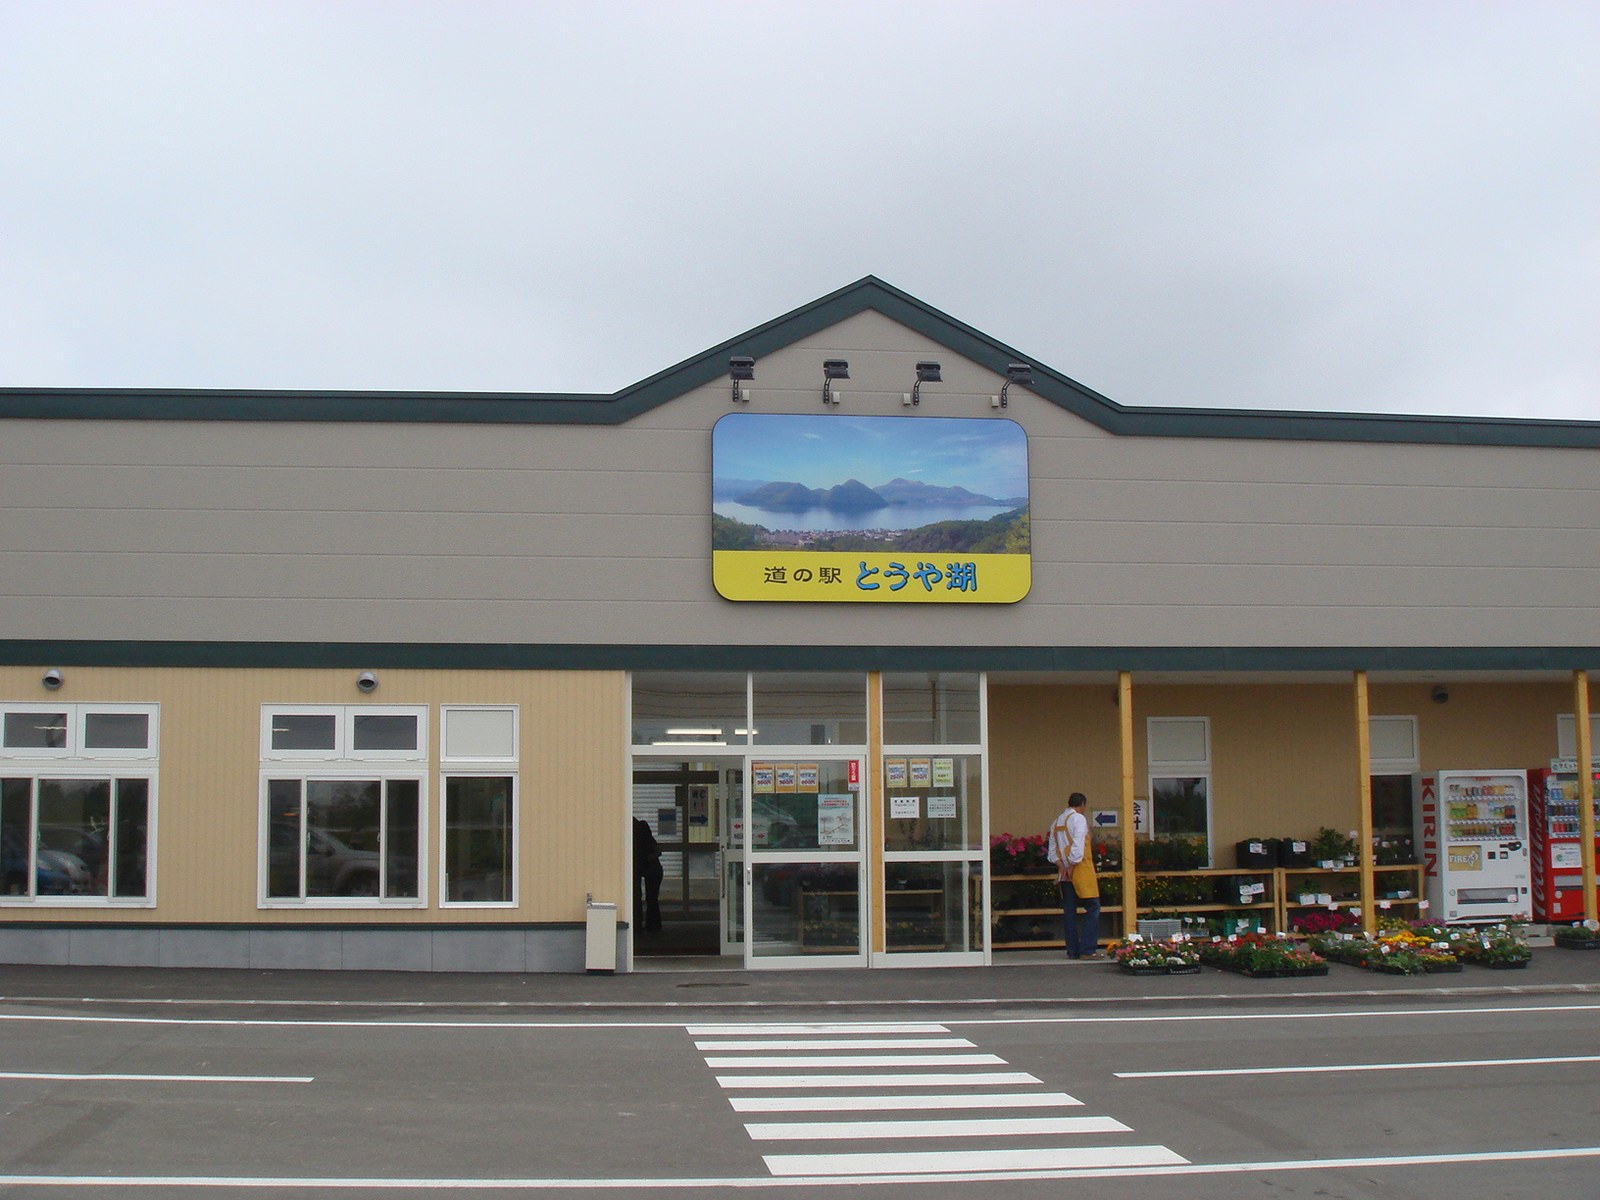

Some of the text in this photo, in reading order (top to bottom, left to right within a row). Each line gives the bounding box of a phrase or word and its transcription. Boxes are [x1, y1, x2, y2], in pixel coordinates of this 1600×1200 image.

[763, 561, 978, 592] 道の駅 とうや湖
[1421, 778, 1437, 877] KIRIN
[1449, 855, 1469, 863] FIRE
